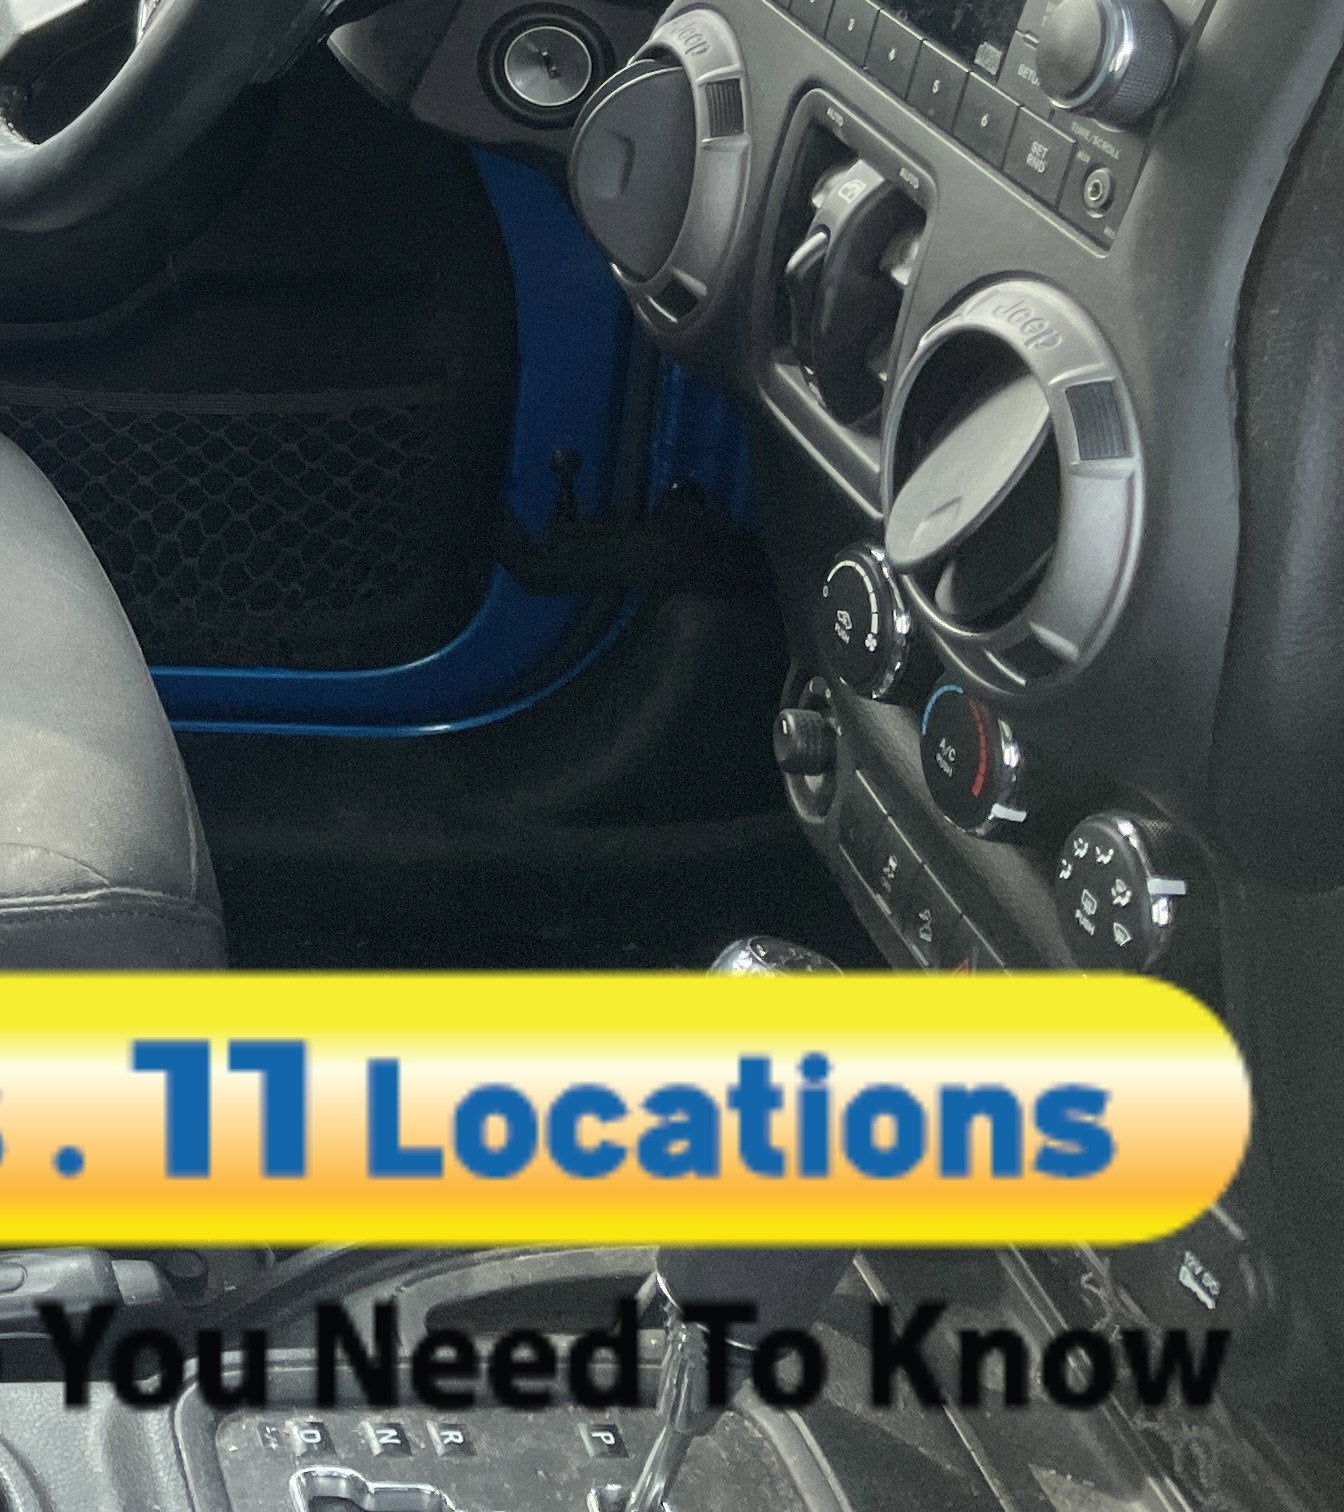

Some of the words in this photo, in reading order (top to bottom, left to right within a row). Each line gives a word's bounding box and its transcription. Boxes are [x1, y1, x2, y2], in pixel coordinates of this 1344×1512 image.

[992, 299, 1064, 350] Jeep
[298, 1428, 322, 1444] D
[375, 1428, 402, 1445] N
[440, 1430, 465, 1445] R
[591, 1431, 616, 1446] P
